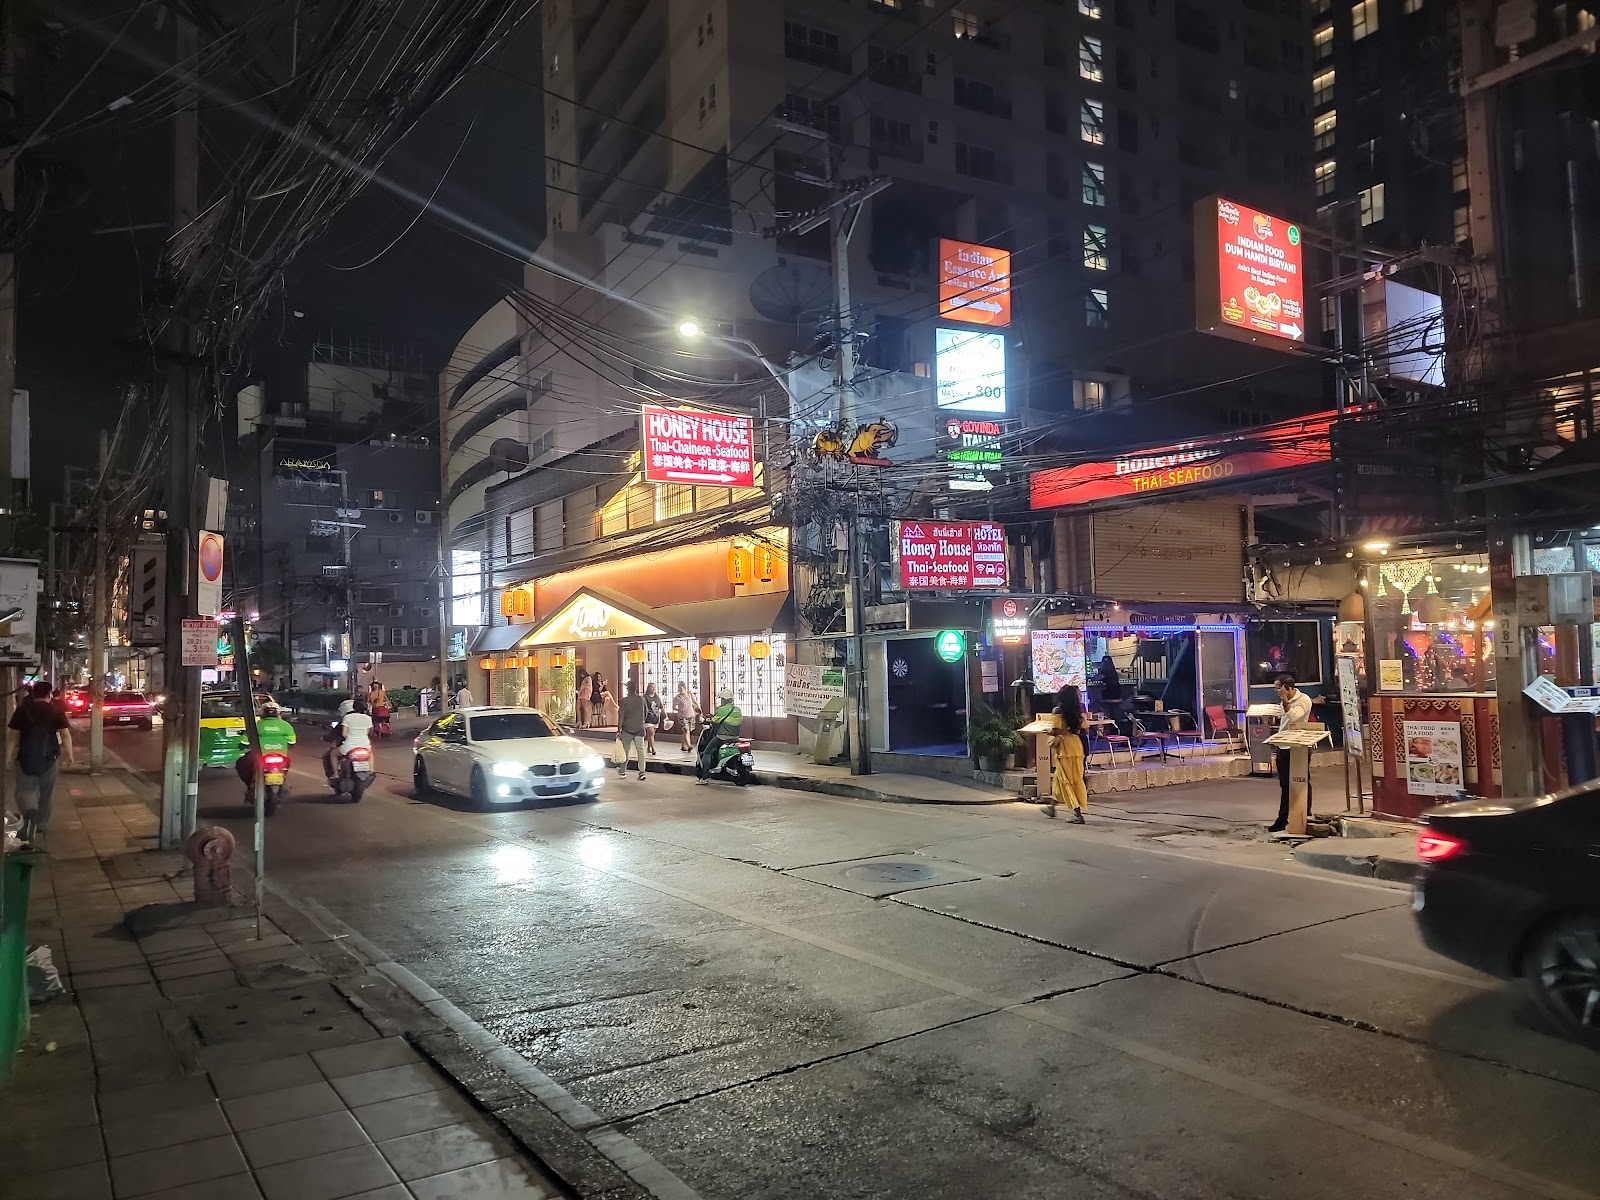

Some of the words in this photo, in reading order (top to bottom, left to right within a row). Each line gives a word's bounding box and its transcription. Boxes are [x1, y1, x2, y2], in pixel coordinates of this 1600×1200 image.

[1237, 236, 1264, 252] INDIAN
[1265, 243, 1284, 259] FOOD
[958, 248, 994, 267] Indian
[1225, 242, 1244, 257] DUM
[1244, 248, 1268, 264] HANDI
[1269, 256, 1296, 274] BIRYANI
[944, 260, 987, 280] Essence
[944, 277, 968, 288] Indian
[976, 385, 1001, 399] 300
[649, 412, 699, 440] HONEY
[702, 417, 748, 445] HOUSE
[962, 420, 1000, 435] GOVINDA
[1132, 463, 1234, 491] THAI-SEAFOOD
[974, 528, 1004, 541] HOTEL
[901, 538, 937, 560] Honey
[939, 540, 972, 556] House
[907, 561, 969, 573] Thai-Seafood
[1032, 632, 1050, 641] Honey
